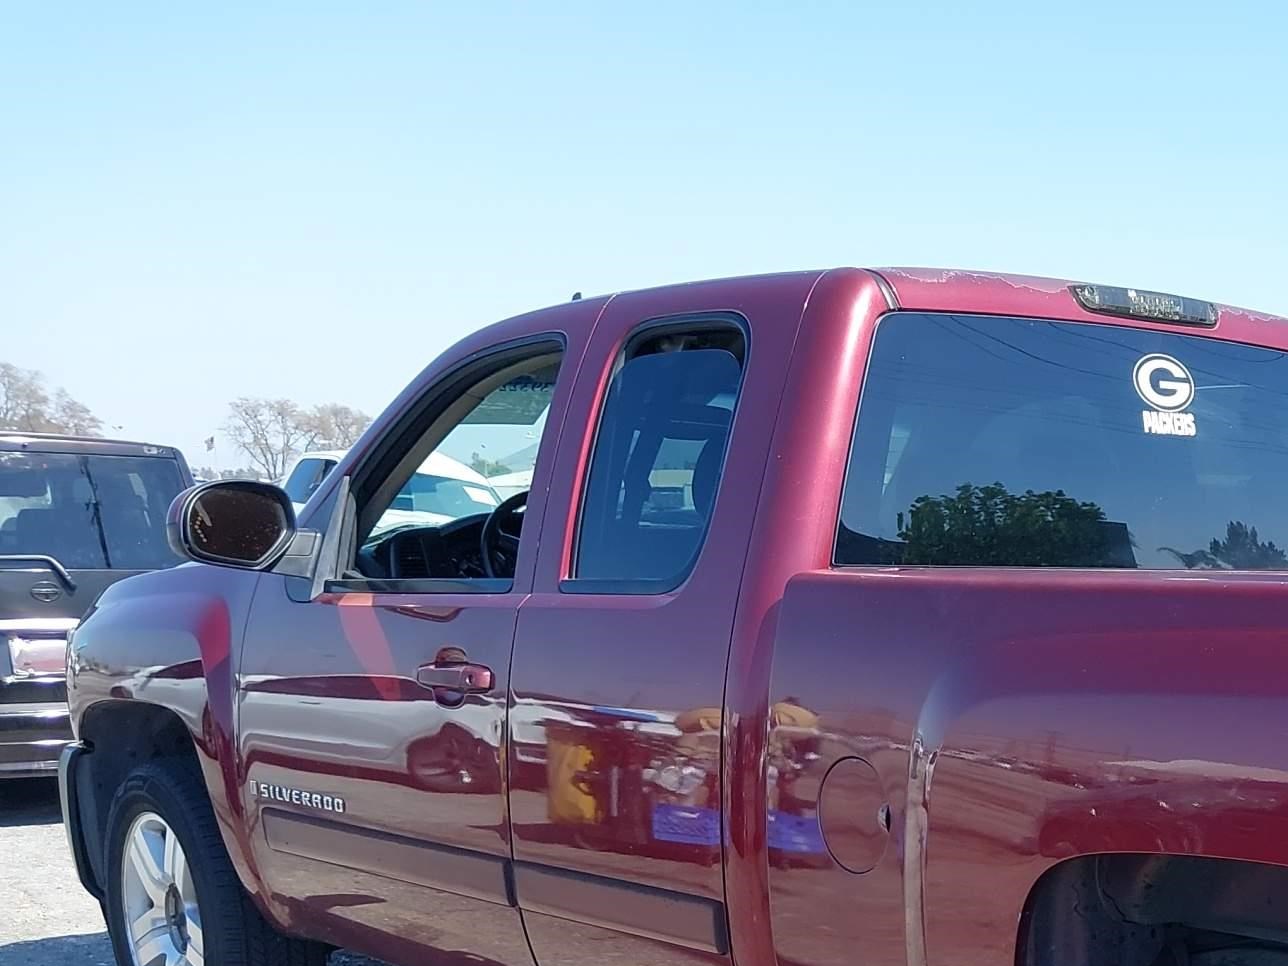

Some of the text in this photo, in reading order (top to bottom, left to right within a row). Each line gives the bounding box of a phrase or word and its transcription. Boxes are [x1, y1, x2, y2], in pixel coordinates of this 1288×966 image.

[1134, 355, 1193, 411] G
[1142, 410, 1197, 437] PACKERS
[260, 783, 345, 814] SILVERADO
